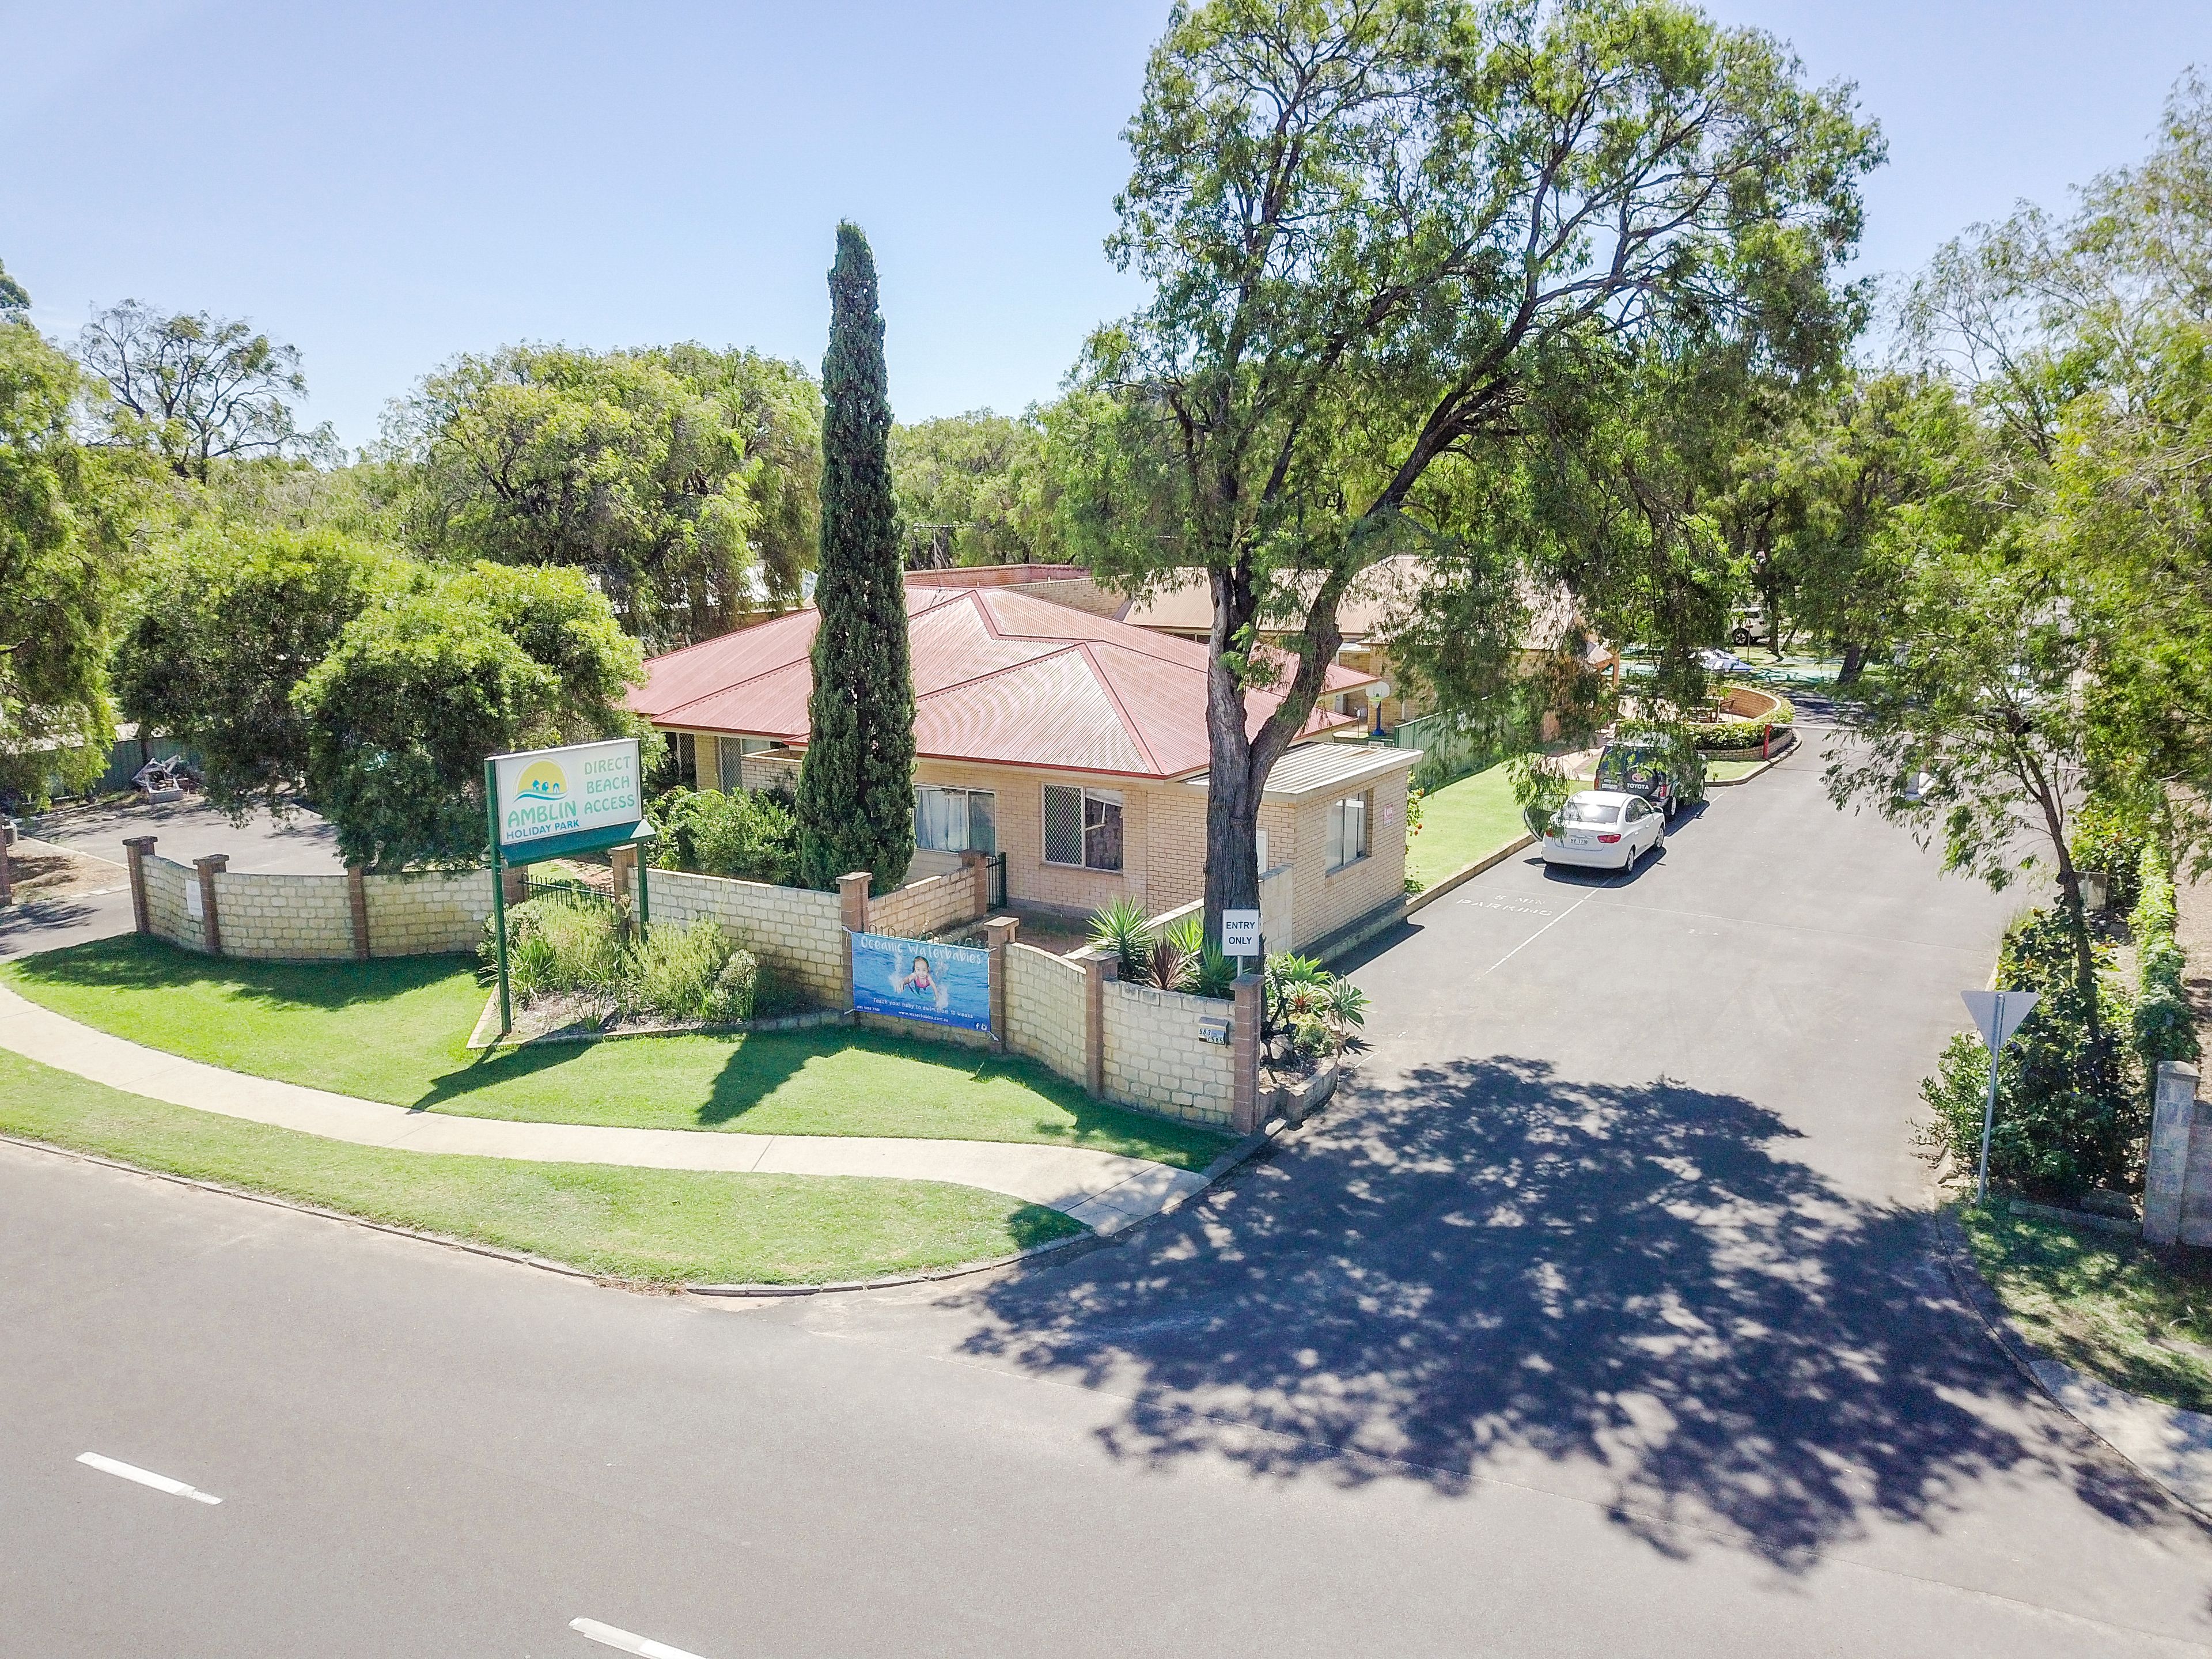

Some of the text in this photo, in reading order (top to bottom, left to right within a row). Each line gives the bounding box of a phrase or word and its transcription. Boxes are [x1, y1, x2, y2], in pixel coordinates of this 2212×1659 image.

[585, 756, 631, 775] DIRECT
[586, 775, 630, 794] BEACH
[507, 800, 577, 828] AMBLIN
[584, 794, 635, 815] ACCESS
[506, 820, 579, 840] HOLIDAY PARK
[1456, 899, 1553, 916] PARKING
[1515, 897, 1545, 905] MIN
[1226, 921, 1255, 929] ENTRY
[861, 936, 982, 964] Oceanic Waterbabies
[1228, 937, 1252, 945] ONLY
